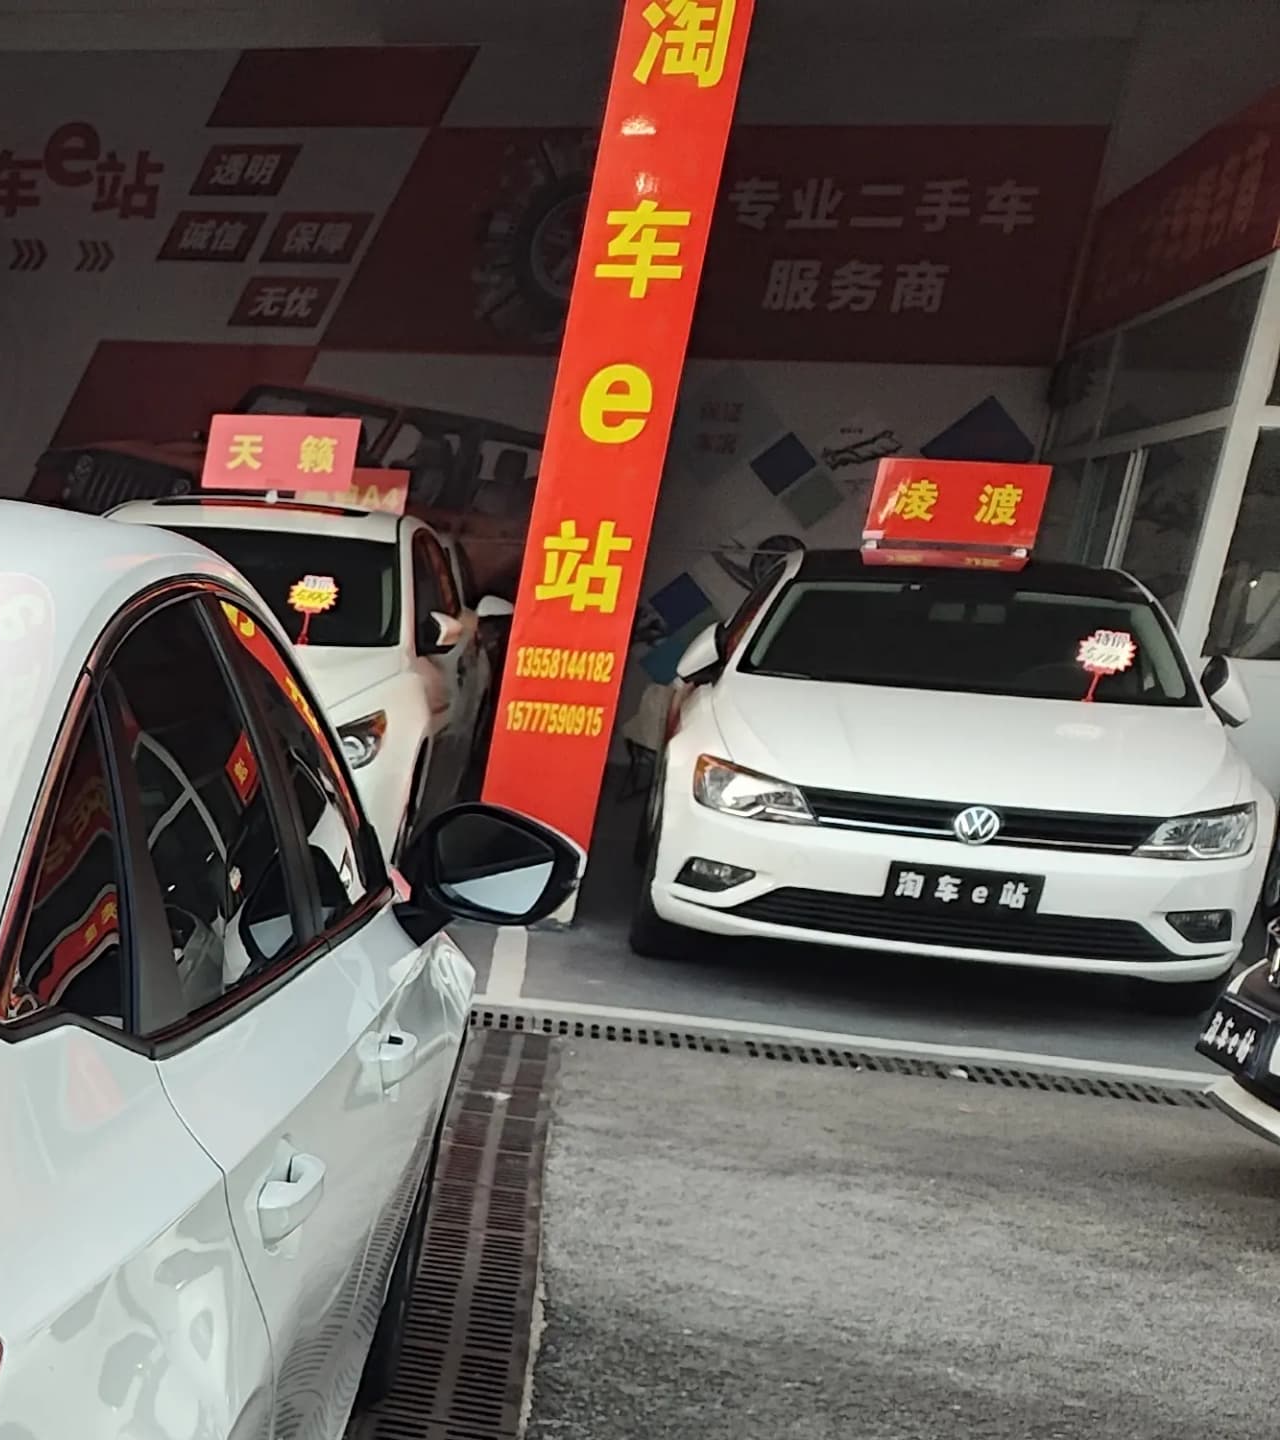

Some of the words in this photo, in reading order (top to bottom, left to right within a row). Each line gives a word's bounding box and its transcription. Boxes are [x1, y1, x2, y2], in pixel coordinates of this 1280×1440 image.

[207, 153, 282, 185] 透明
[728, 177, 1040, 233] 专业二手车
[177, 219, 248, 252] 诚信
[282, 220, 353, 255] 保障
[761, 259, 951, 314] 服务商
[536, 0, 733, 615] 淘车e站
[892, 480, 1025, 528] 凌渡
[516, 646, 615, 685] 13558144182
[505, 700, 604, 737] 15777590915
[895, 871, 1029, 909] 淘车e站
